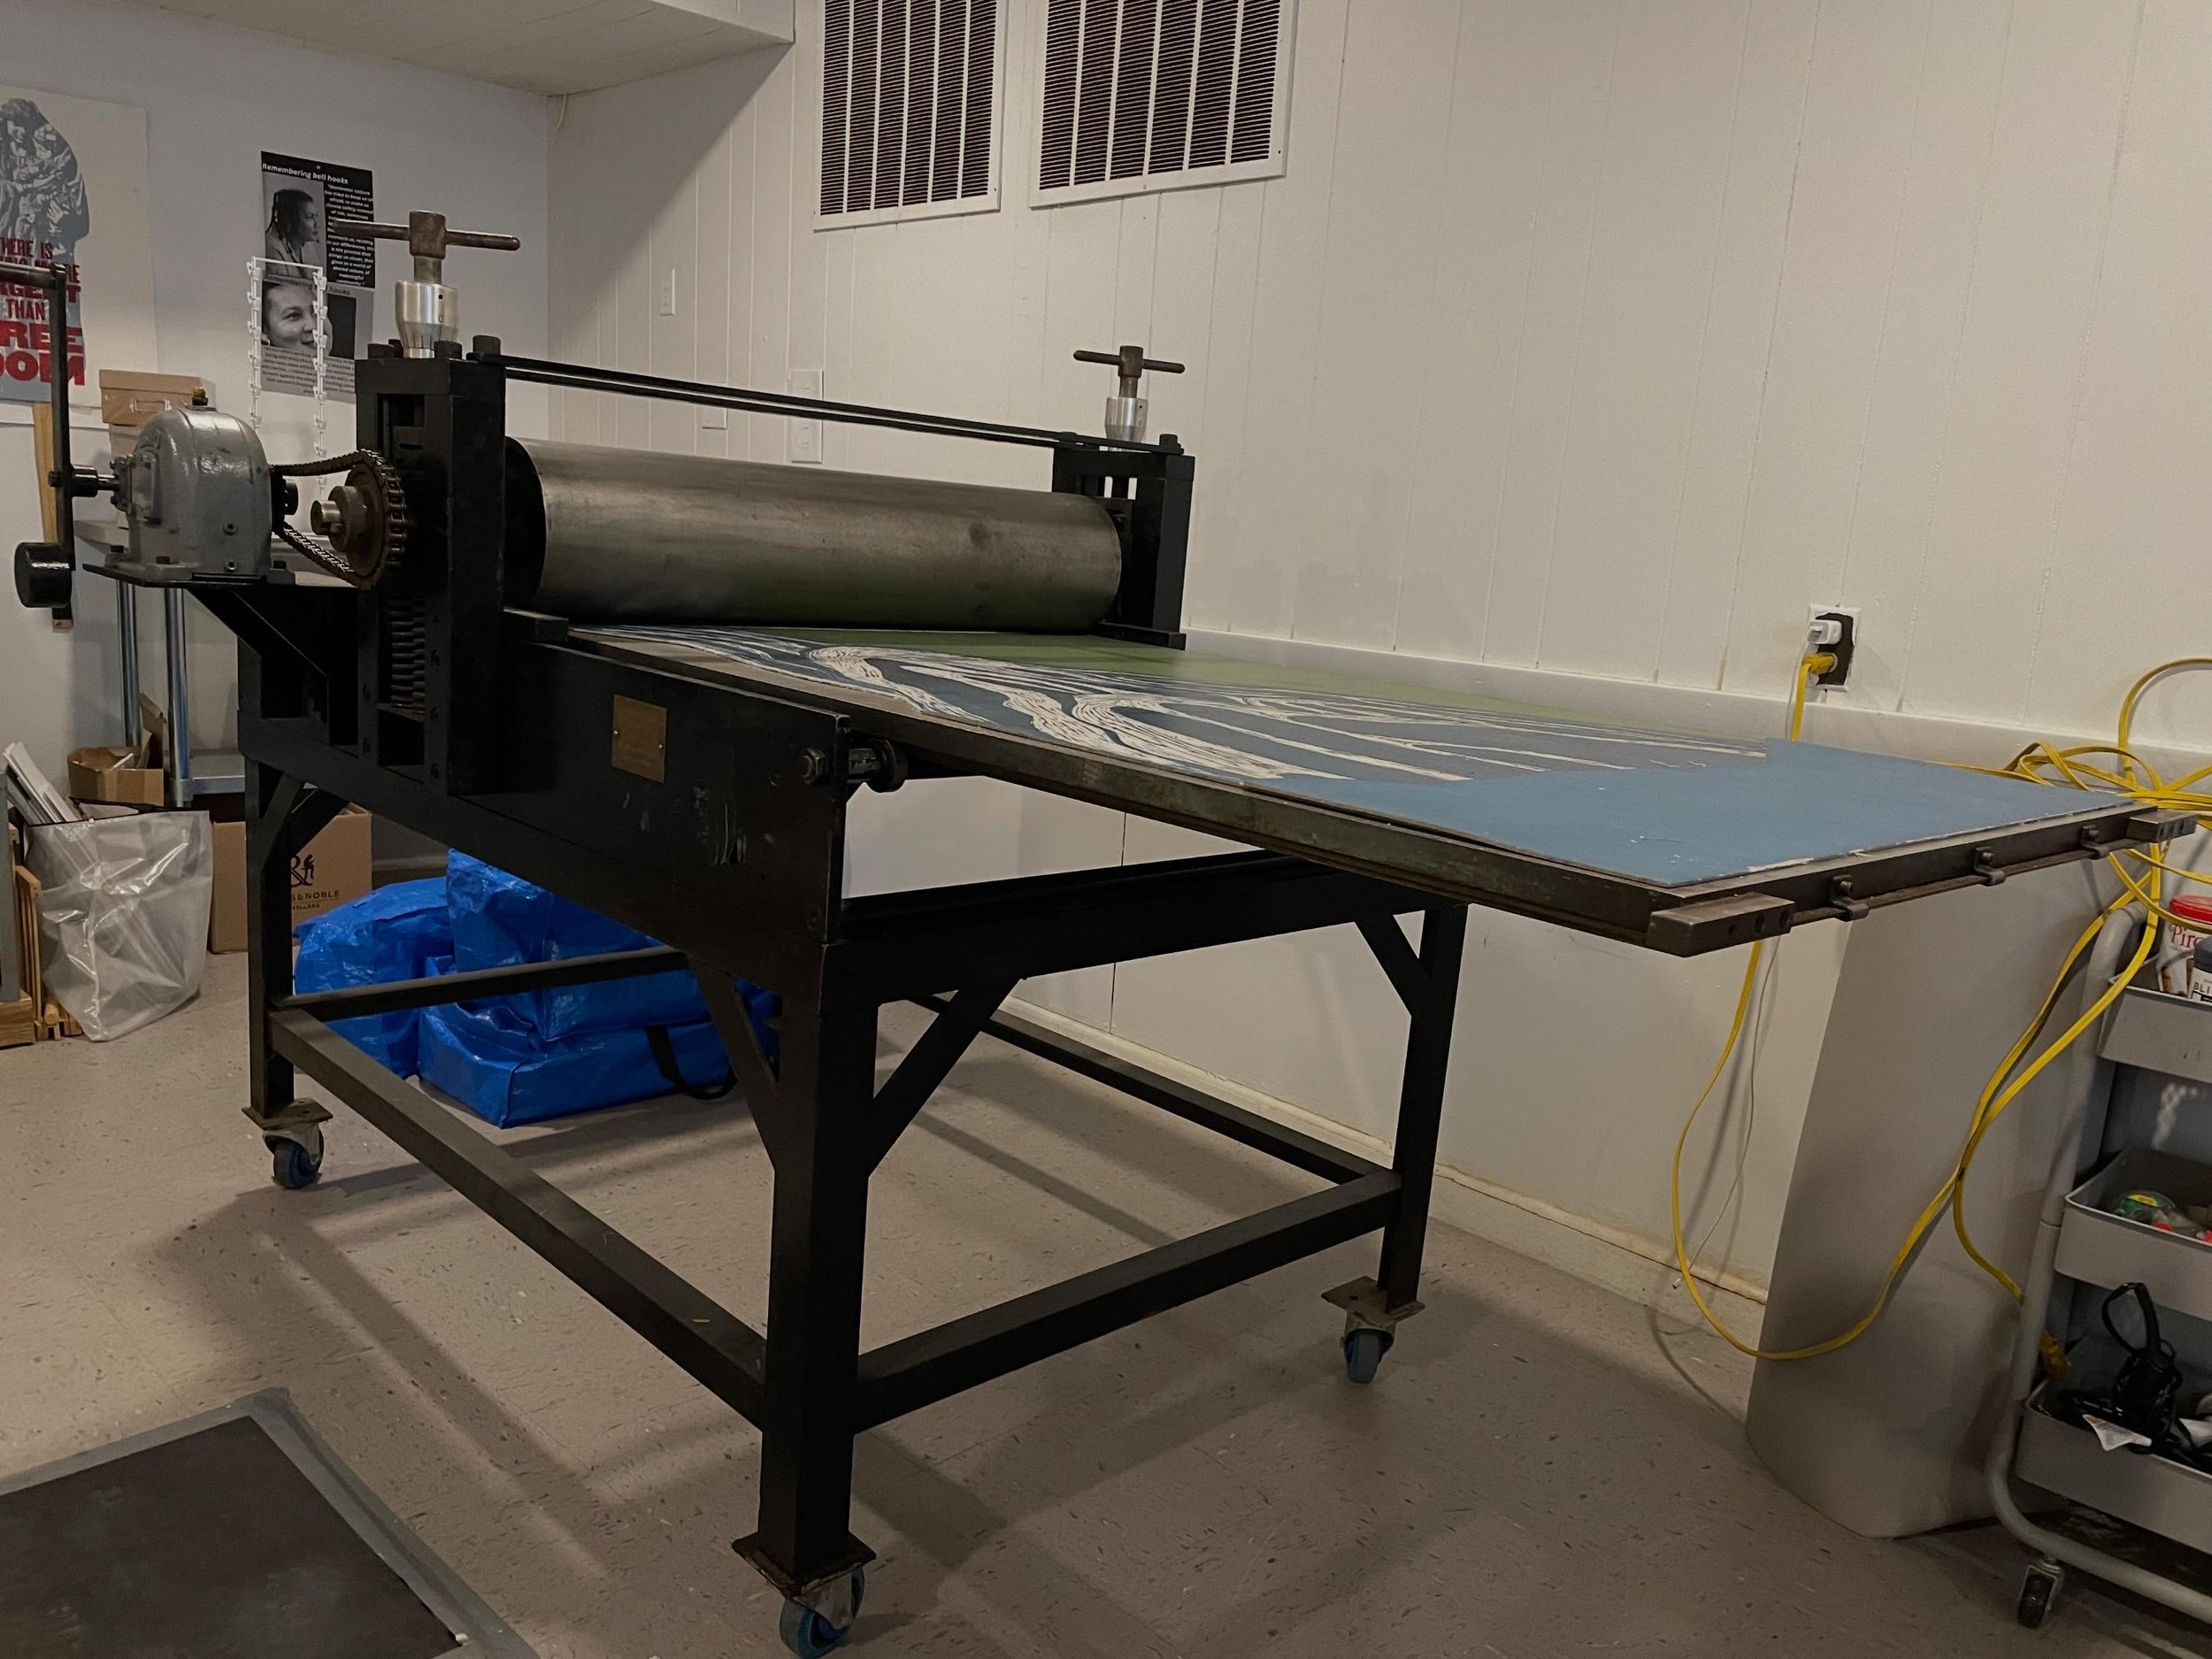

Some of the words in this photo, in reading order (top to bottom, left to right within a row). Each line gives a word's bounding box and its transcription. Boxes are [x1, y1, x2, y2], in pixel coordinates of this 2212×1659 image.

[262, 163, 311, 180] Remembering
[312, 172, 326, 181] bell
[326, 174, 349, 185] hooks
[0, 237, 34, 258] HERE
[41, 241, 53, 259] IS
[6, 298, 46, 320] THAN
